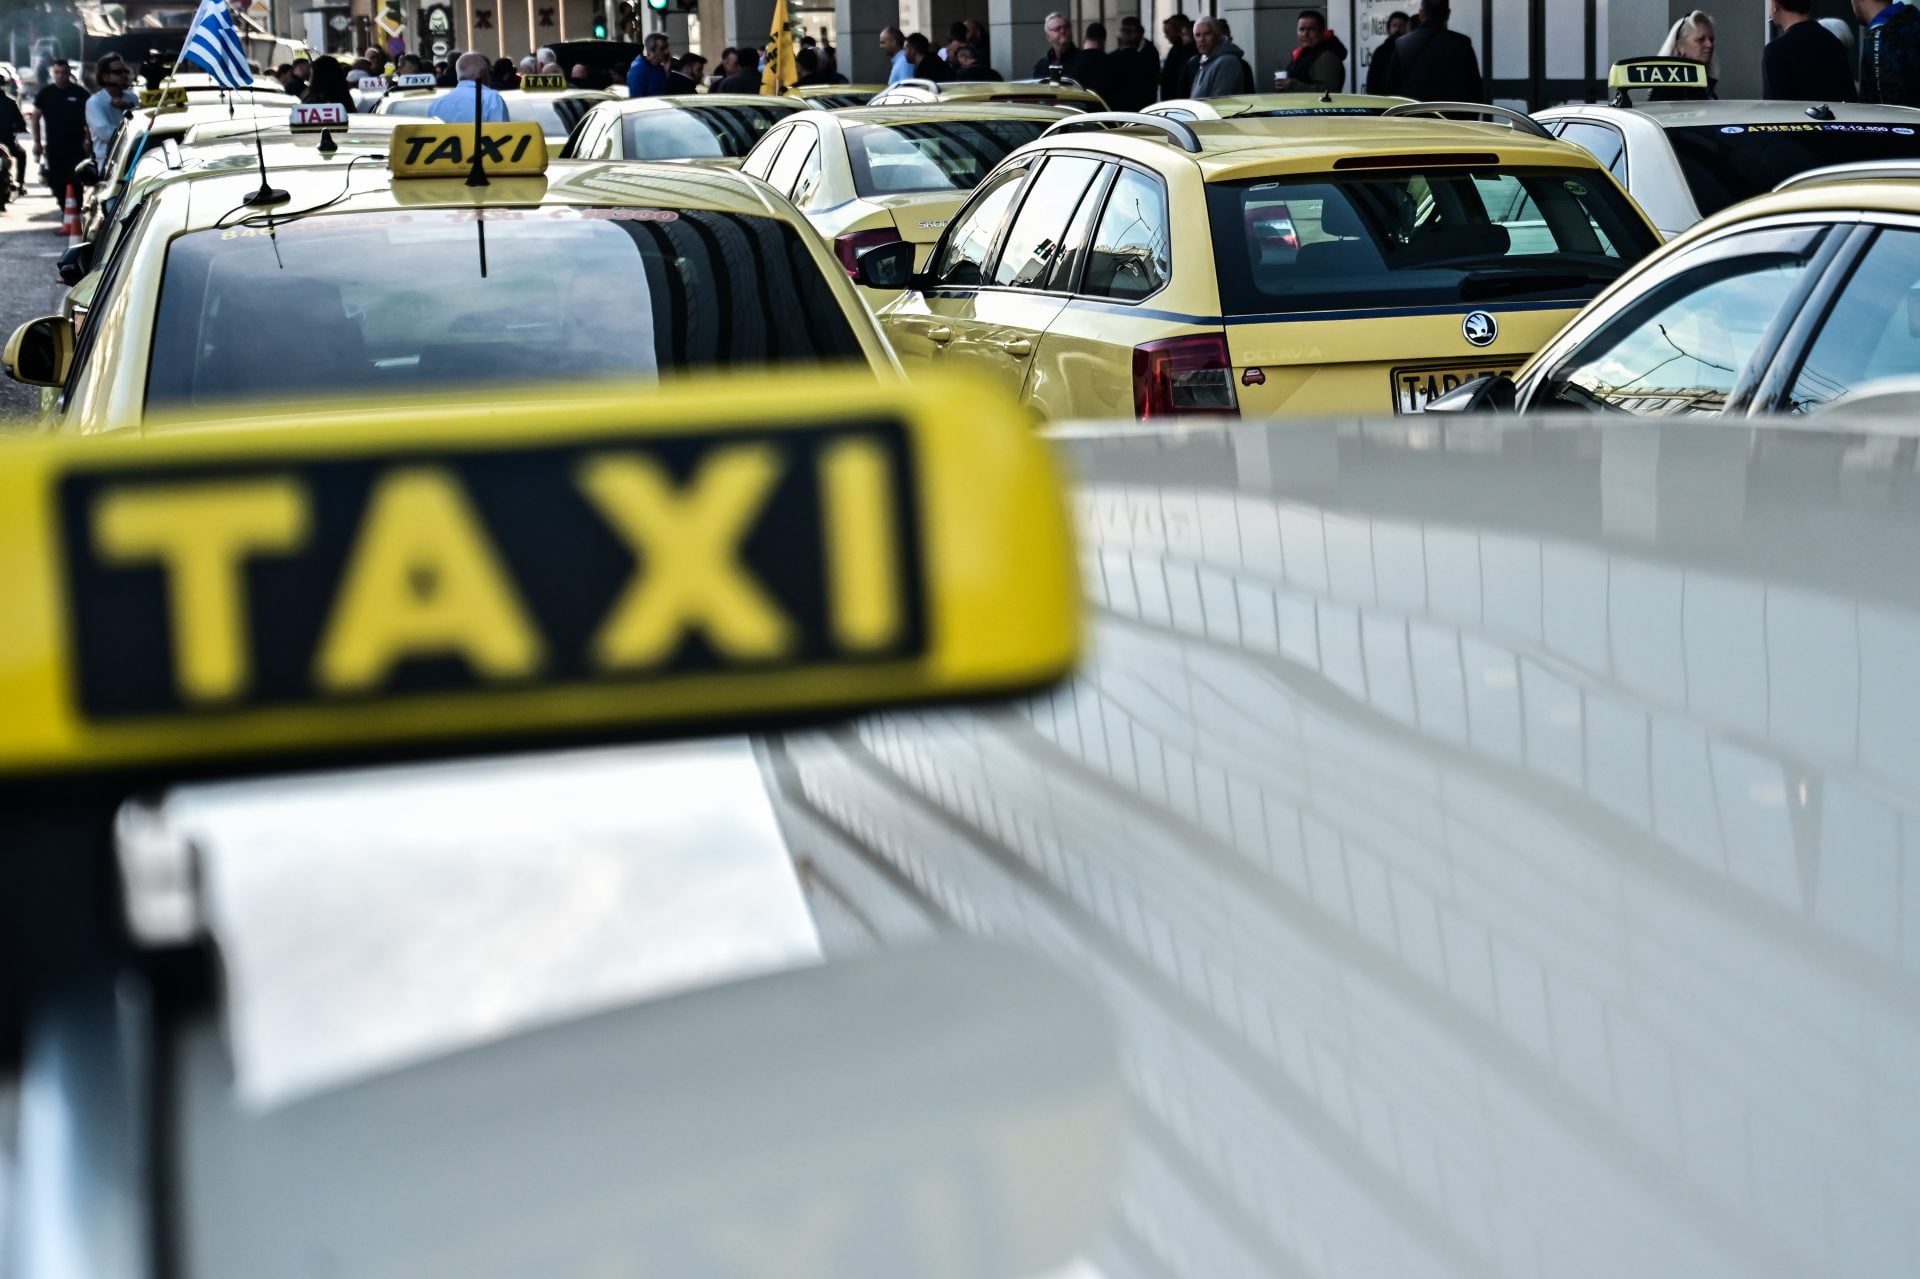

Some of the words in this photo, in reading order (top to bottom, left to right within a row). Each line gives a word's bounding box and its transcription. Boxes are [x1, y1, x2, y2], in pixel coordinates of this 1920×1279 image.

[527, 76, 560, 87] TAXI
[1636, 66, 1689, 82] TAXI
[297, 107, 340, 123] ΤΑΞΙ
[405, 135, 532, 166] TAXI
[1243, 347, 1323, 362] OCTAVIA
[92, 443, 902, 703] TAXI
